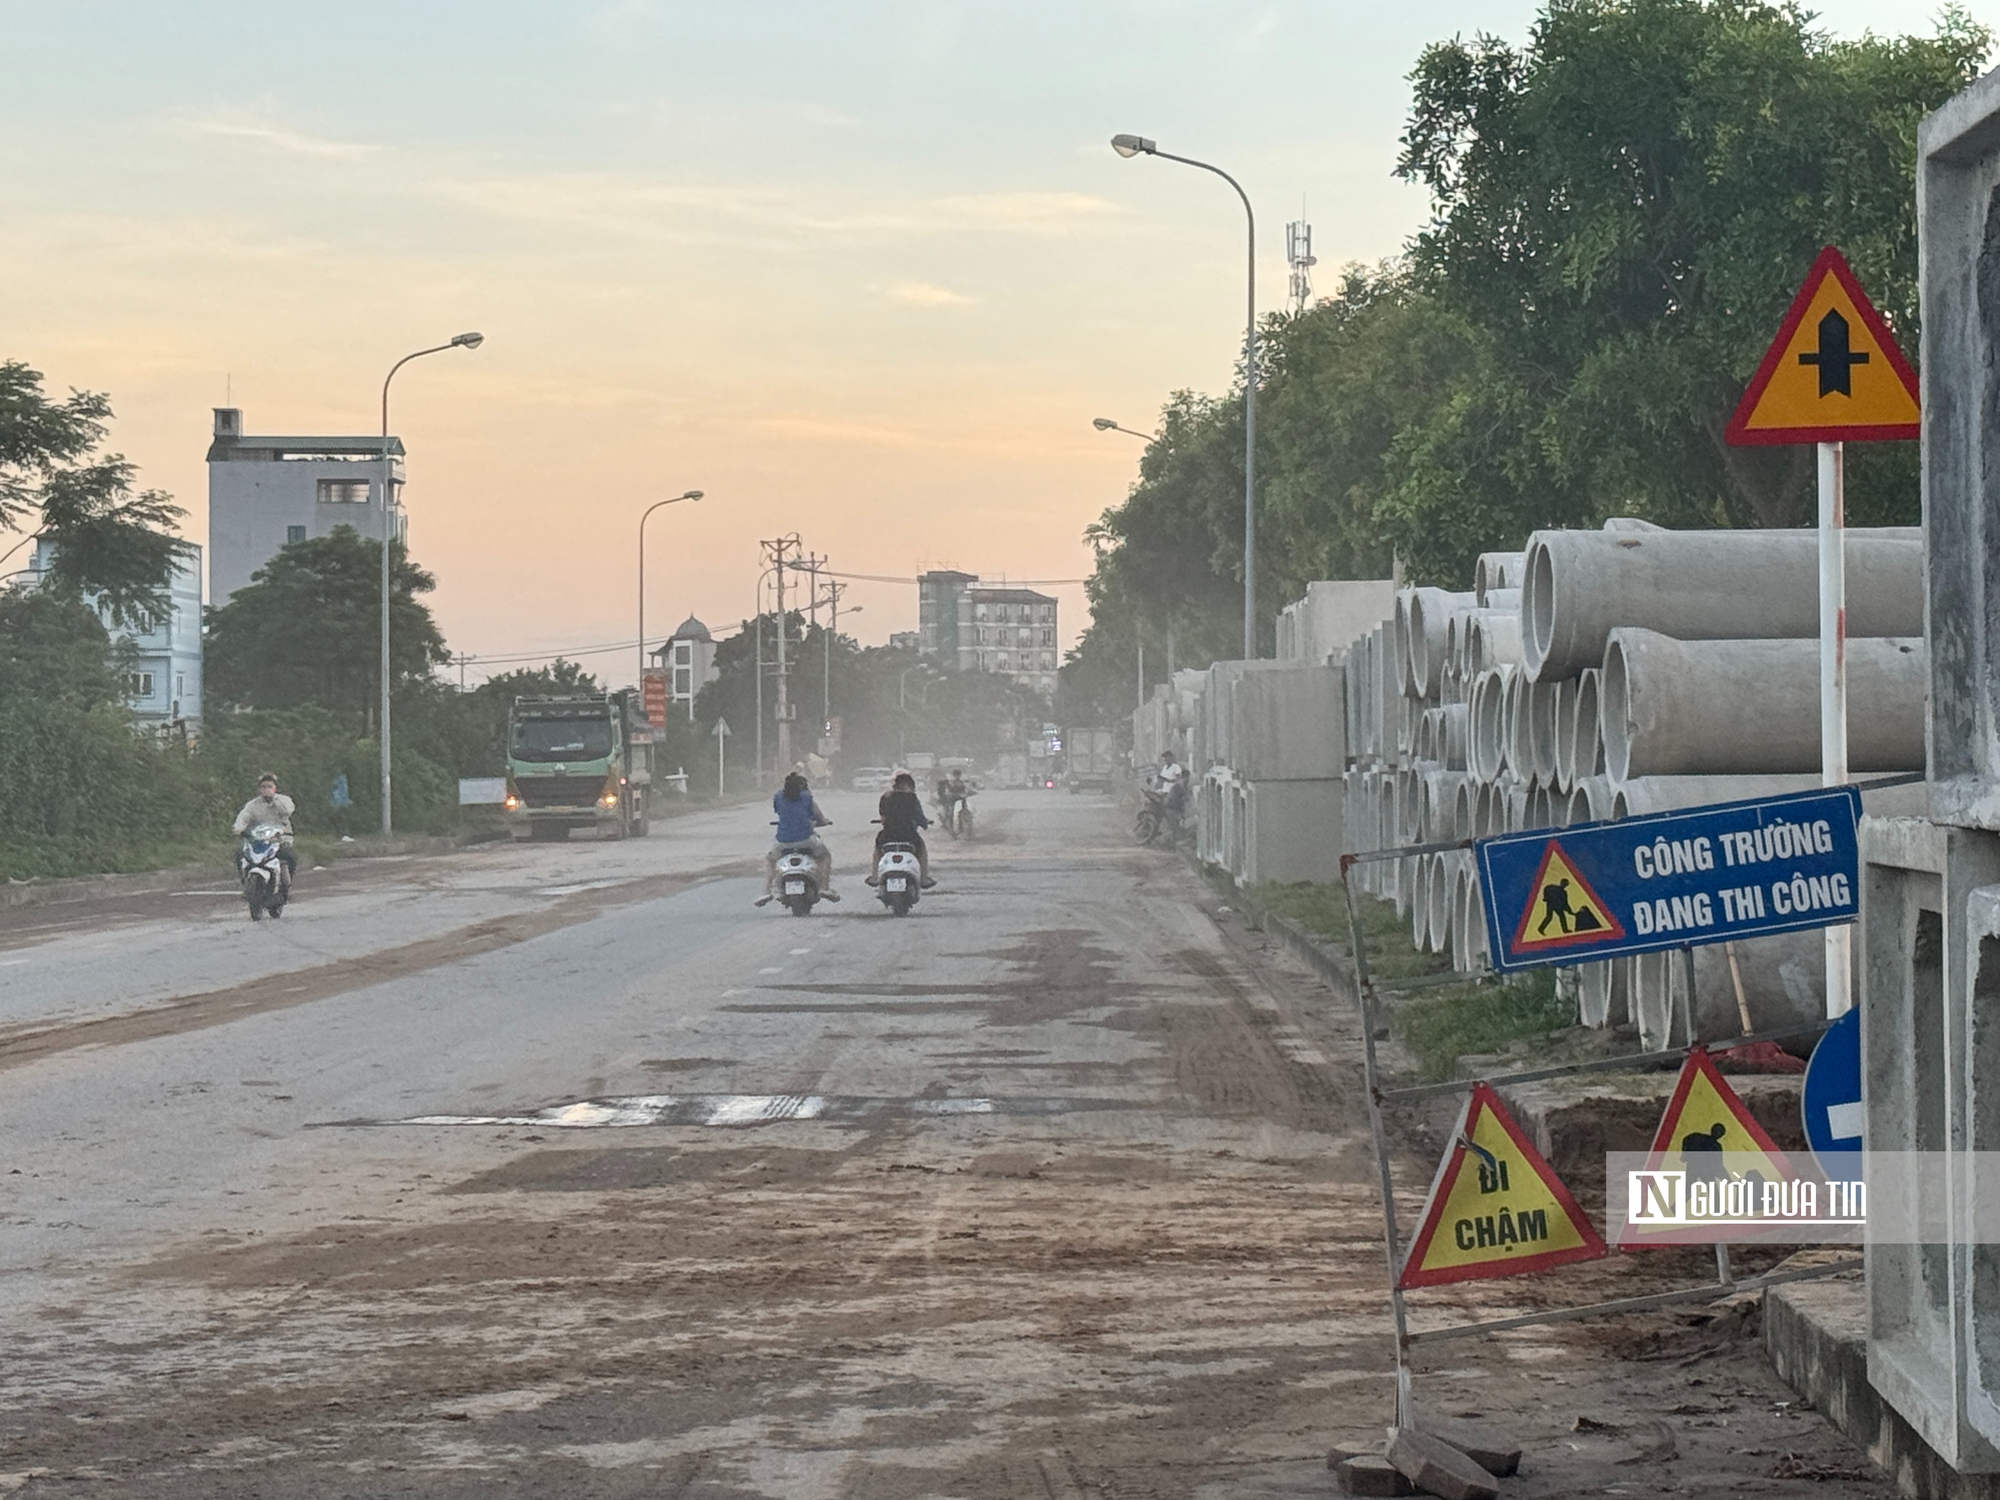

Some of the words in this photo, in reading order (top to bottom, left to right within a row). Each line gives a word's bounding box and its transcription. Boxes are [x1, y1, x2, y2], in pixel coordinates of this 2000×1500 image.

[1634, 836, 1715, 879] CÔNG
[1719, 817, 1833, 867] TRƯỜNG
[1633, 893, 1714, 935] ĐANG
[1718, 885, 1766, 923] THI
[1772, 872, 1851, 915] CÔNG
[1477, 1160, 1510, 1195] ĐI
[1454, 1206, 1548, 1252] CHẬM
